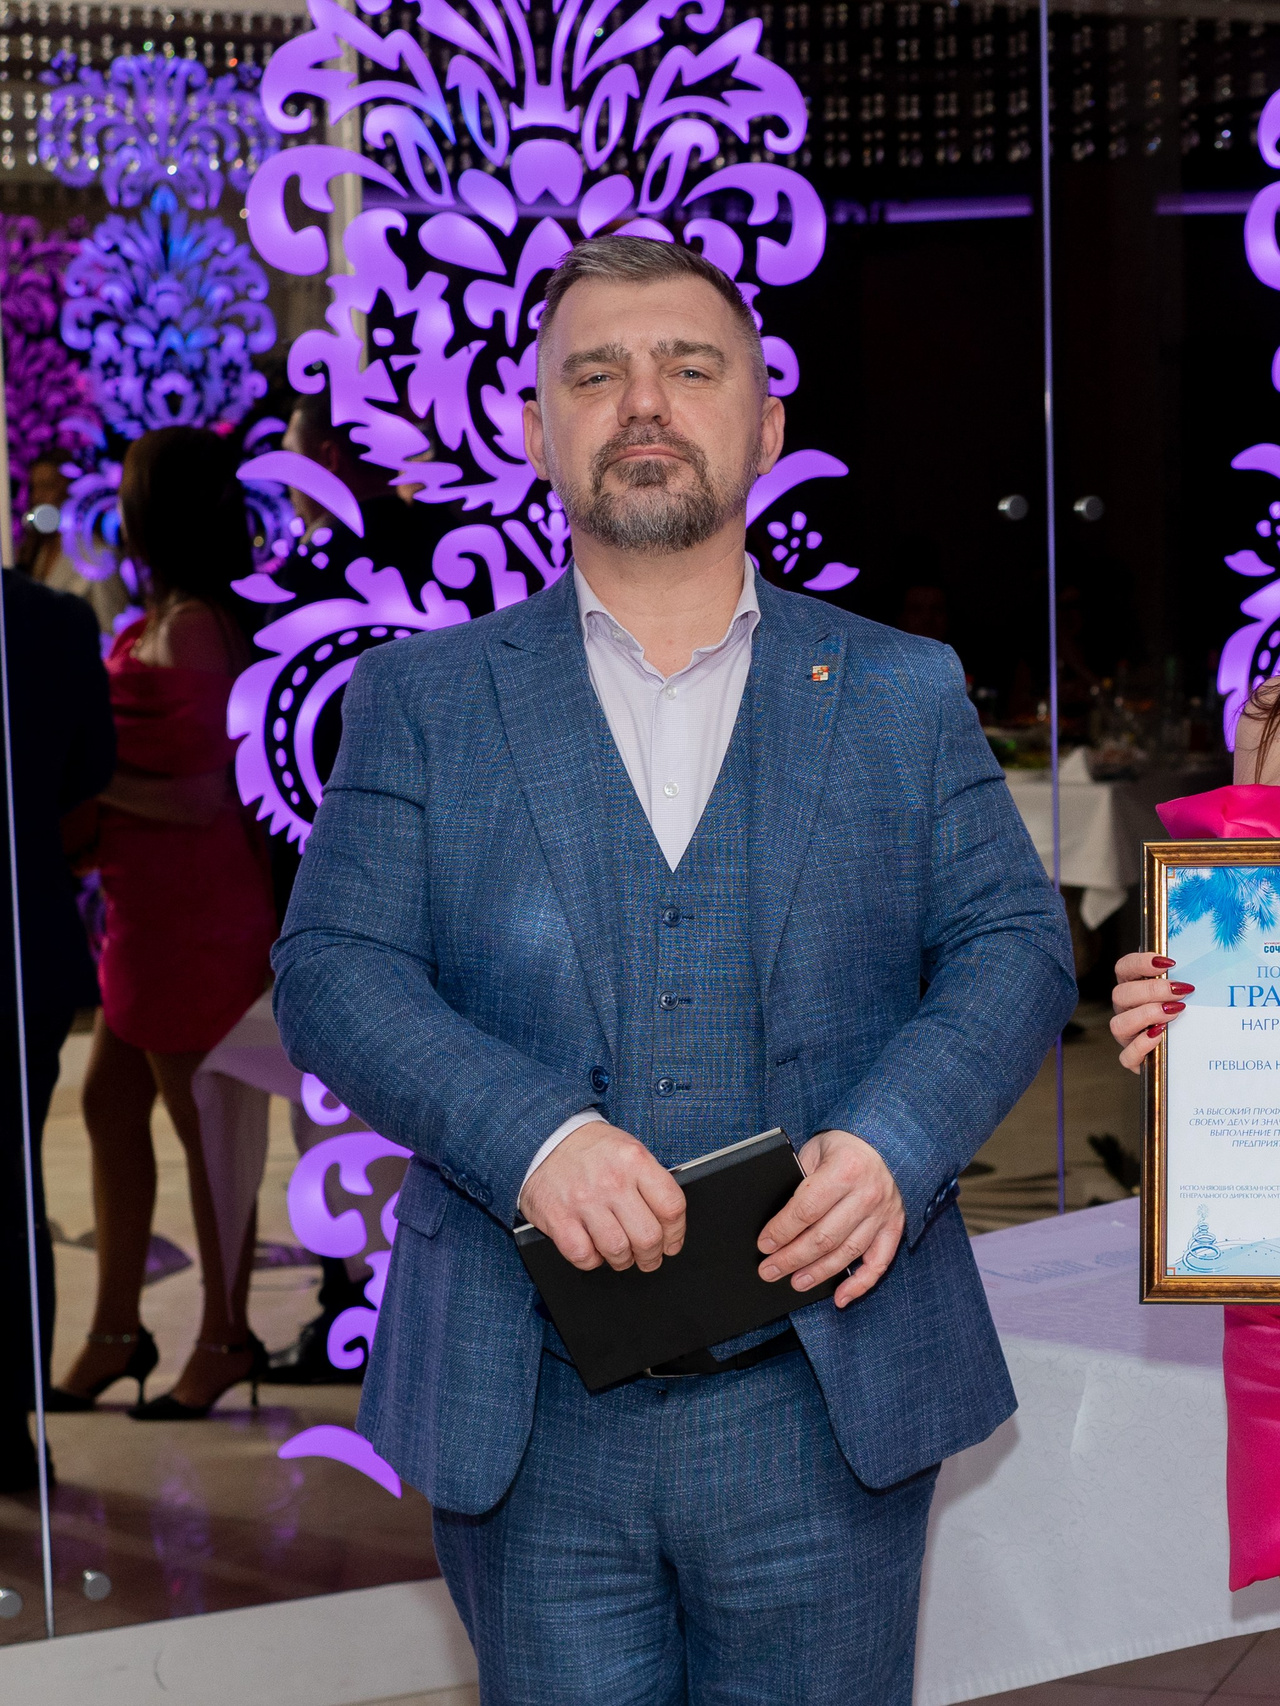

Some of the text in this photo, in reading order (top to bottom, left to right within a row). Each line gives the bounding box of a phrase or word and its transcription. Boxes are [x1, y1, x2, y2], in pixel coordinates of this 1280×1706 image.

[1208, 1060, 1272, 1070] ГРЕВЦОВА
[1206, 1107, 1251, 1115] ВЫСОКИЙ
[1189, 1118, 1225, 1126] СВОЕМУ
[1227, 1118, 1251, 1126] ДЕЛУ
[1252, 1118, 1259, 1126] И
